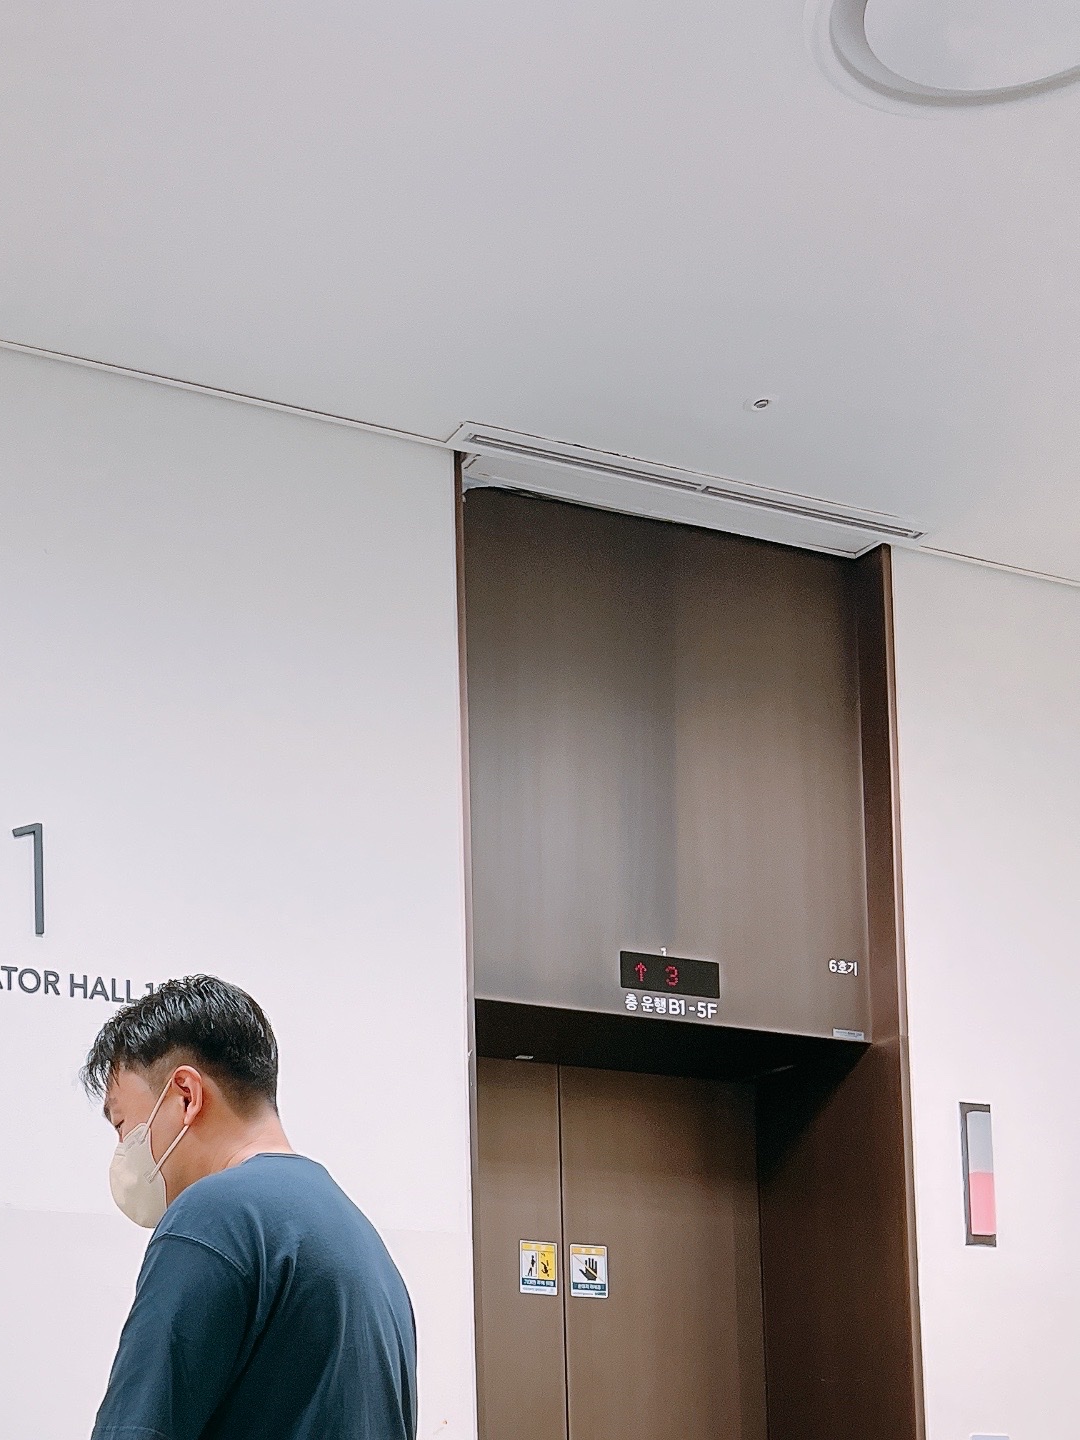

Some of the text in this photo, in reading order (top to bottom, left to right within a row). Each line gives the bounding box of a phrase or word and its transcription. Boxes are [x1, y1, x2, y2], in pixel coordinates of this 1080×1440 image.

[12, 822, 44, 936] 1
[665, 965, 678, 987] 3
[828, 959, 858, 976] 6호기
[69, 973, 140, 1004] HALL
[625, 993, 638, 1011] 층
[641, 995, 667, 1014] 운행
